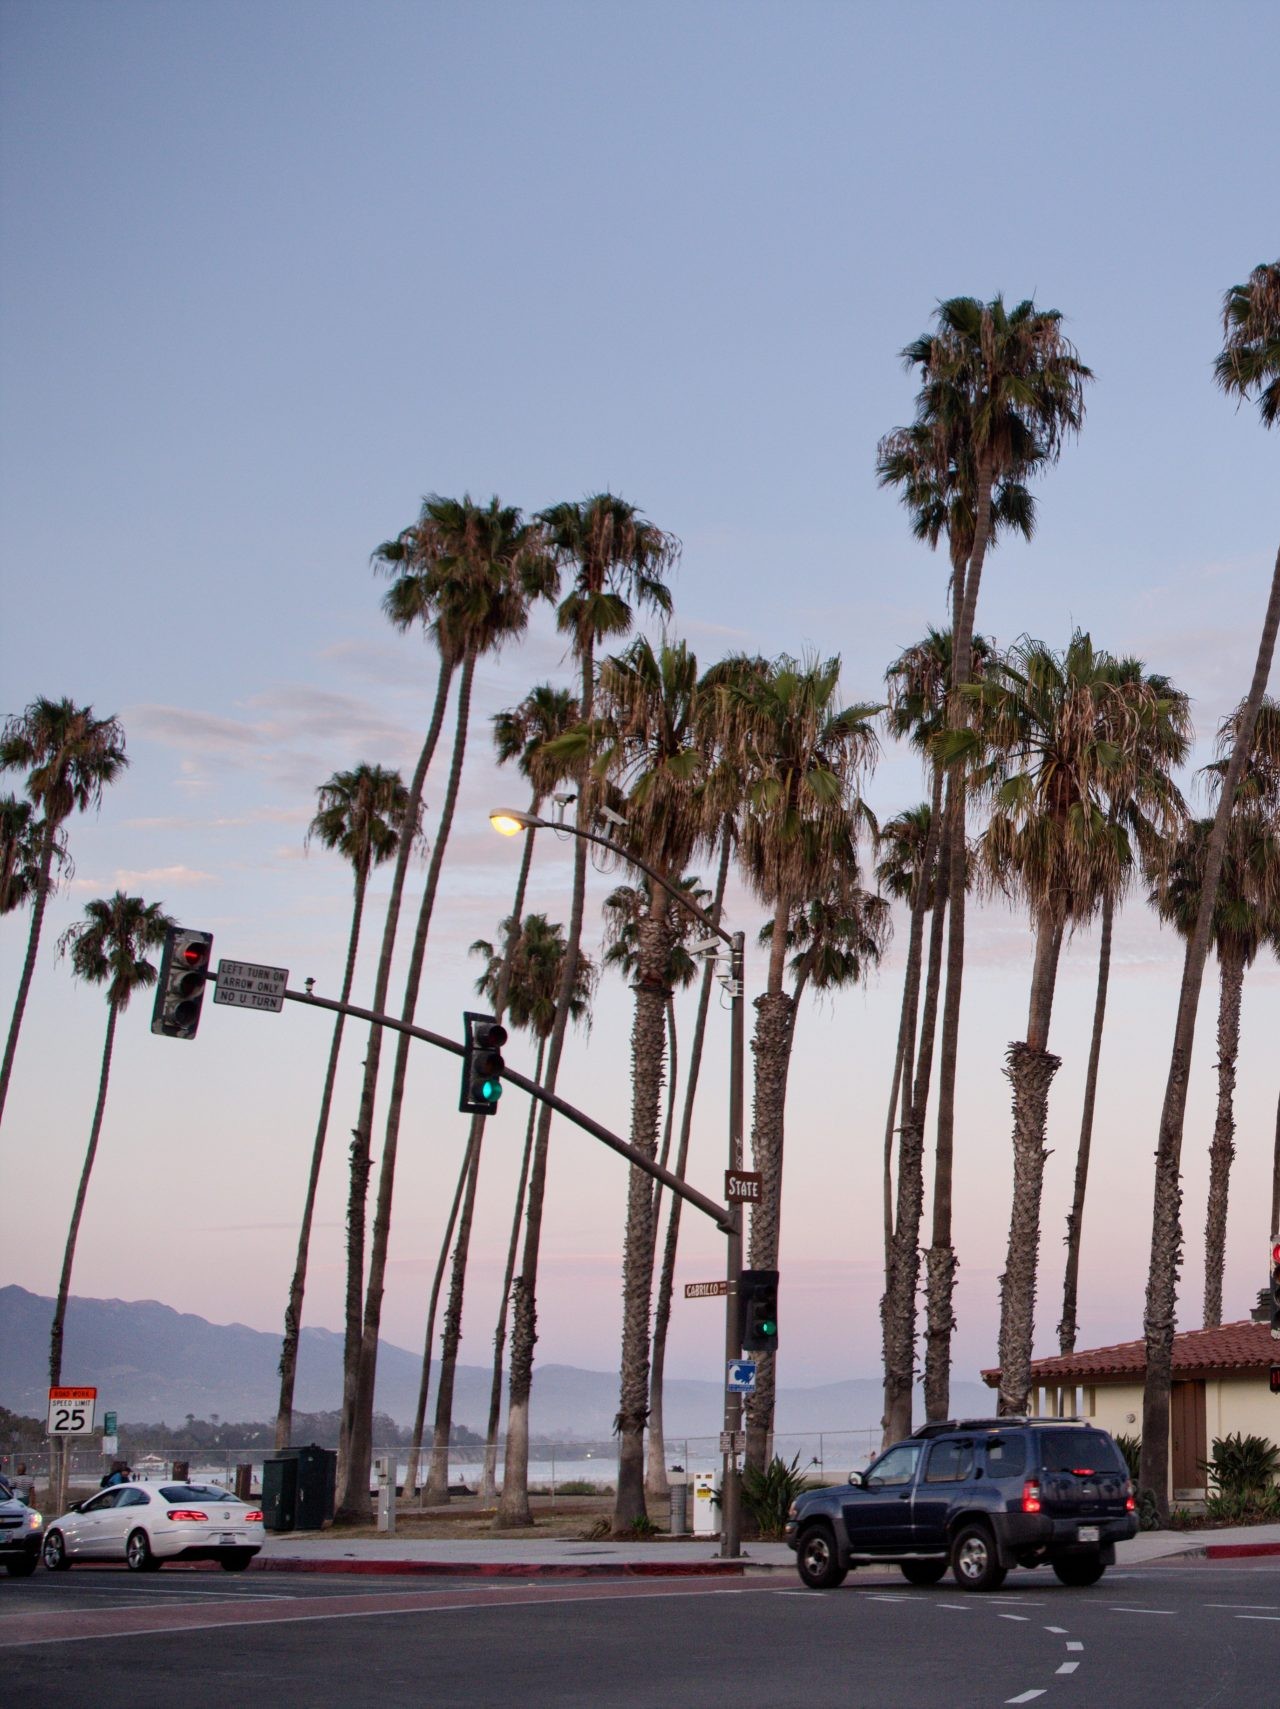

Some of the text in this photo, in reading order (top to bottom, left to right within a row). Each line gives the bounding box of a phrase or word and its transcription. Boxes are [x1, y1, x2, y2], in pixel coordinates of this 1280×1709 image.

[221, 963, 286, 982] LEFT TURN ON
[223, 977, 279, 993] ARROW ONLY
[220, 991, 278, 1008] NO U TURN
[686, 1283, 719, 1297] CABRILLO
[54, 1409, 85, 1431] 25
